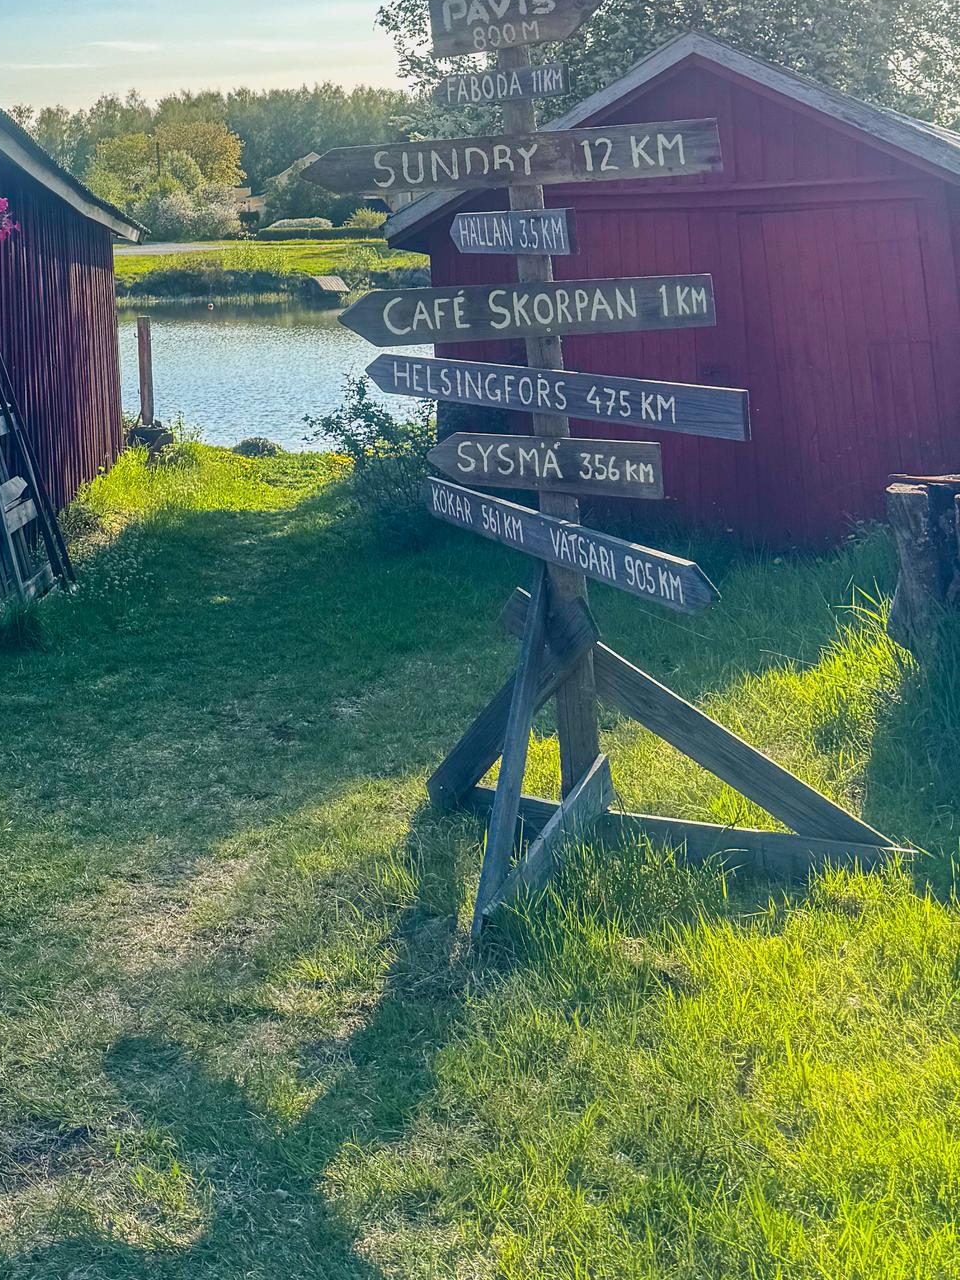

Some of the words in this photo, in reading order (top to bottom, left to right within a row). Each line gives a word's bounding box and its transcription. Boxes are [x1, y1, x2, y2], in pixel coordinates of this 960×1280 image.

[473, 23, 516, 50] 800
[522, 20, 539, 40] M
[447, 71, 522, 103] FÄBODA
[581, 137, 619, 172] 12
[630, 132, 686, 168] KM
[459, 217, 514, 247] HÄLLAN
[383, 290, 471, 335] CAFÉ
[488, 288, 637, 330] SKORPAN
[659, 285, 668, 317] 1
[676, 285, 707, 316] KM
[393, 361, 567, 410] HELSINGFORS
[586, 385, 631, 417] 475
[640, 391, 676, 424] KM
[457, 441, 563, 479] SYSMÄ
[580, 452, 620, 480] 356
[625, 459, 654, 483] KM
[431, 484, 472, 524] KÖKAR
[481, 504, 500, 534] 561
[503, 512, 524, 543] KM
[549, 527, 616, 581] VÄTSÄRI
[624, 555, 655, 594] 905
[658, 565, 683, 604] KM
